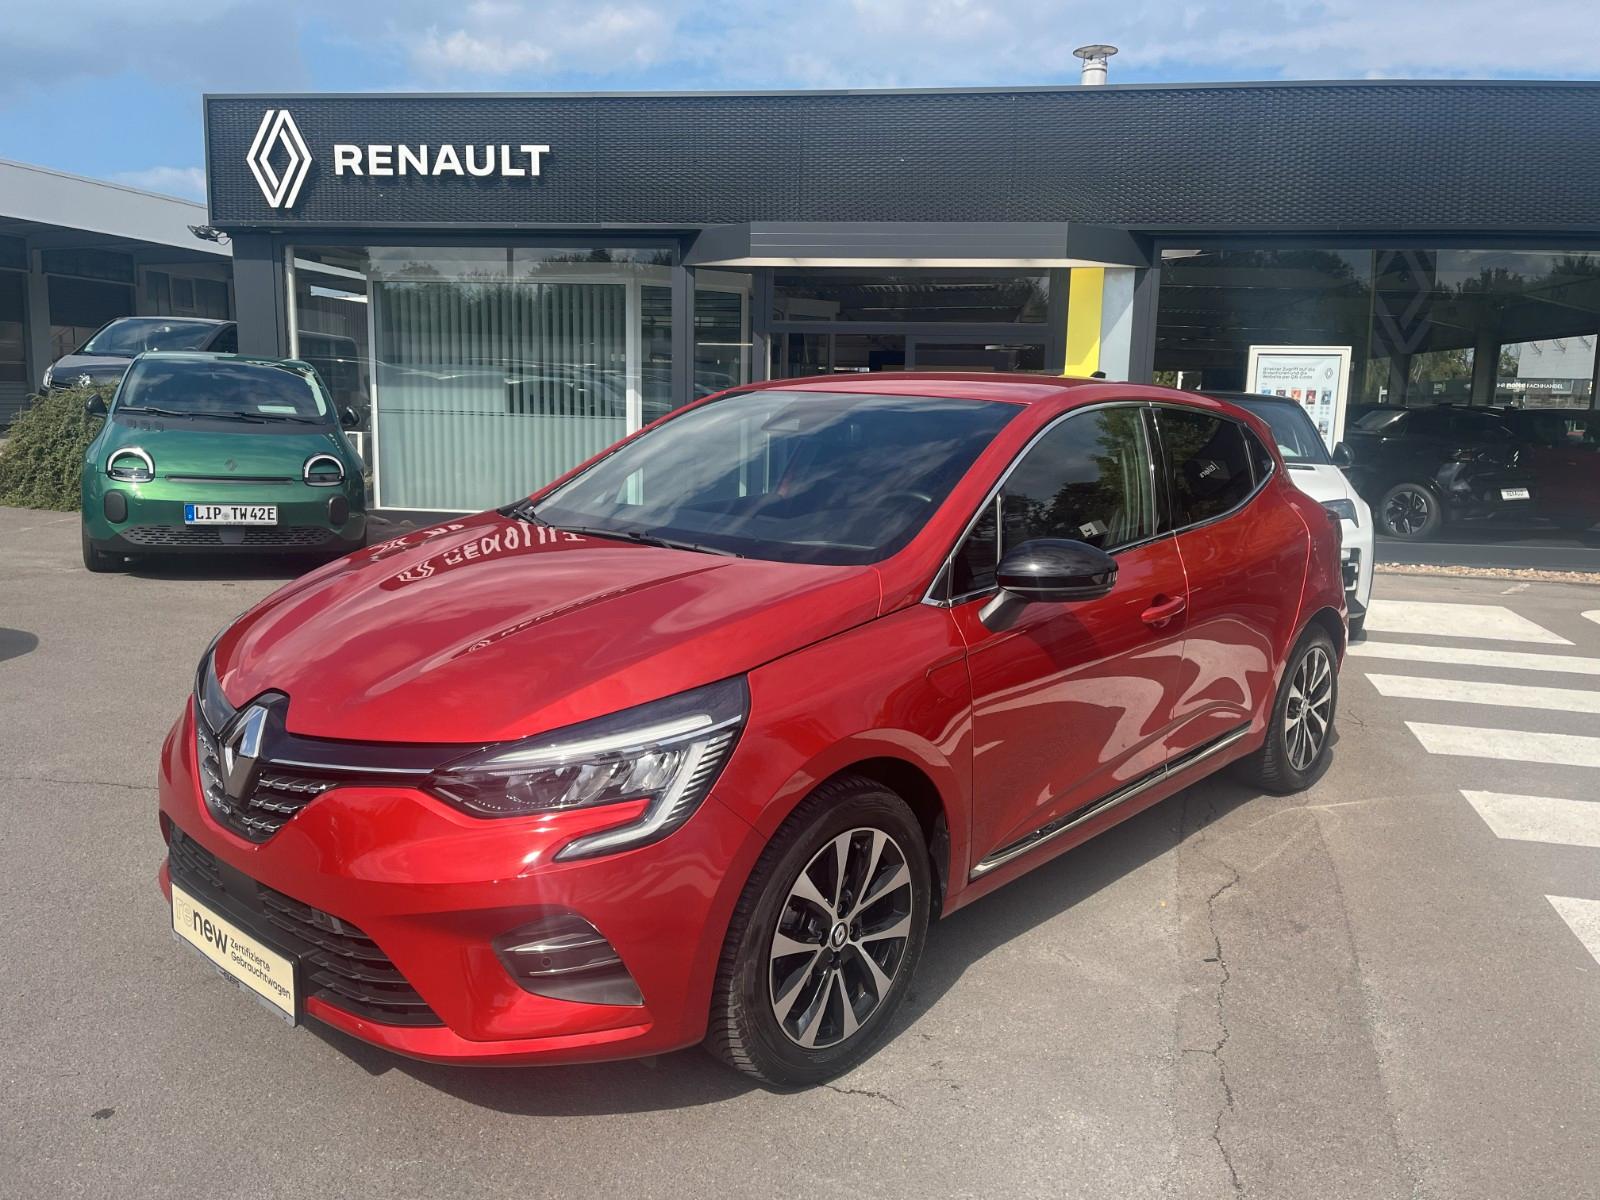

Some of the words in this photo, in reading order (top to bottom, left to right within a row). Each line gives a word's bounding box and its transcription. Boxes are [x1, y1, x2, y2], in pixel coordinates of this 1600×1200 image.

[334, 144, 550, 176] RENAULT
[195, 507, 222, 520] LIP
[231, 507, 247, 520] TW
[250, 507, 275, 520] 42E
[230, 938, 271, 972] Zertifizierte
[230, 952, 291, 1000] Gebrauchtwagen
